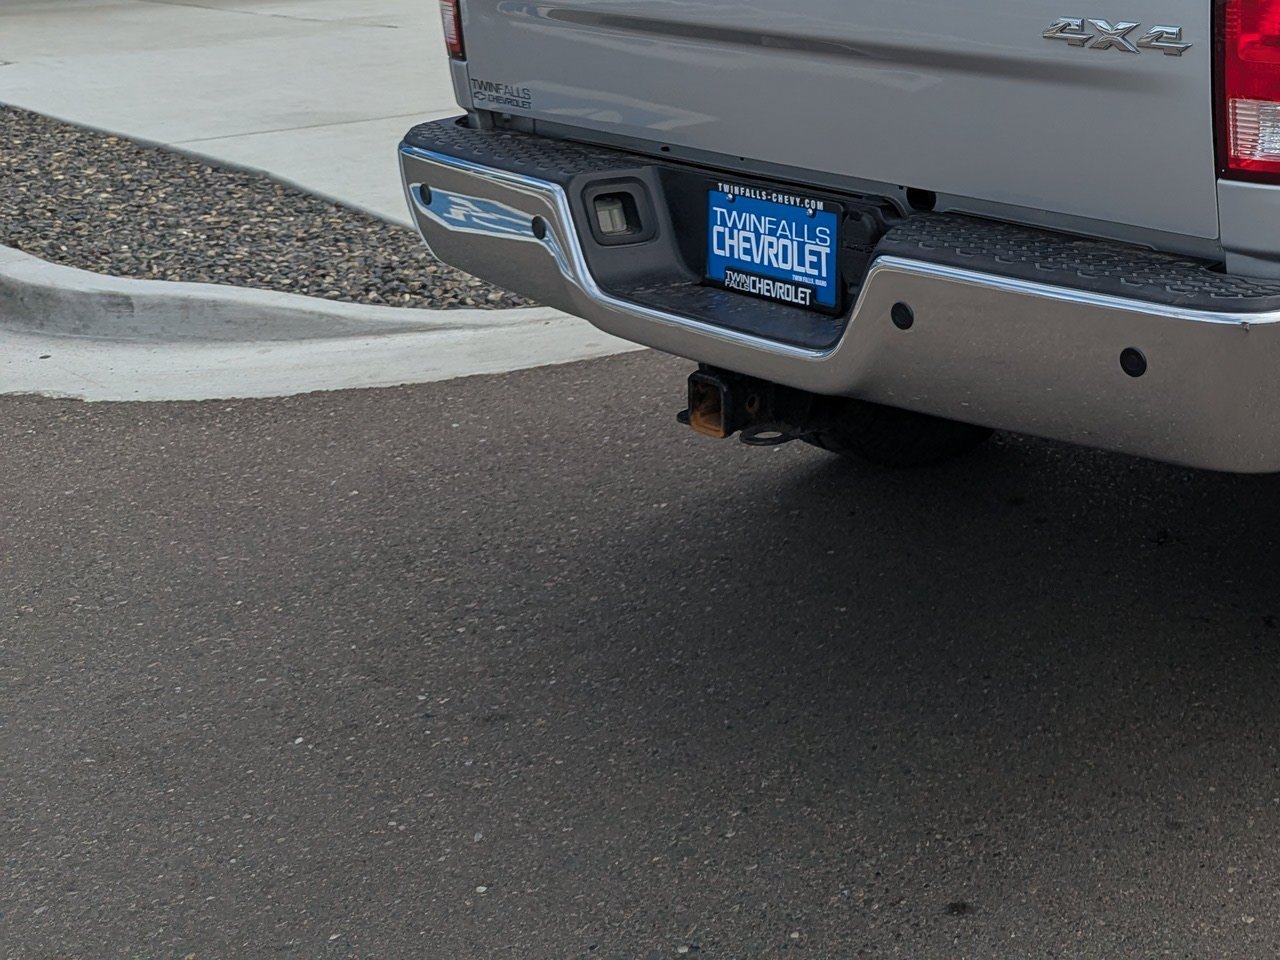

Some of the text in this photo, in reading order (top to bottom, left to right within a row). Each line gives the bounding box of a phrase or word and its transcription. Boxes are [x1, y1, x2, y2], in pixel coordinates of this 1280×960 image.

[488, 94, 532, 110] CHEVROLET
[717, 182, 825, 211] TWINFALLS-CHEVY.COM
[712, 207, 831, 246] TWINFALLS
[712, 225, 831, 278] CHEVROLET
[724, 278, 750, 292] FALLS
[725, 270, 750, 284] TWIN
[749, 276, 812, 306] CHEVROLET
